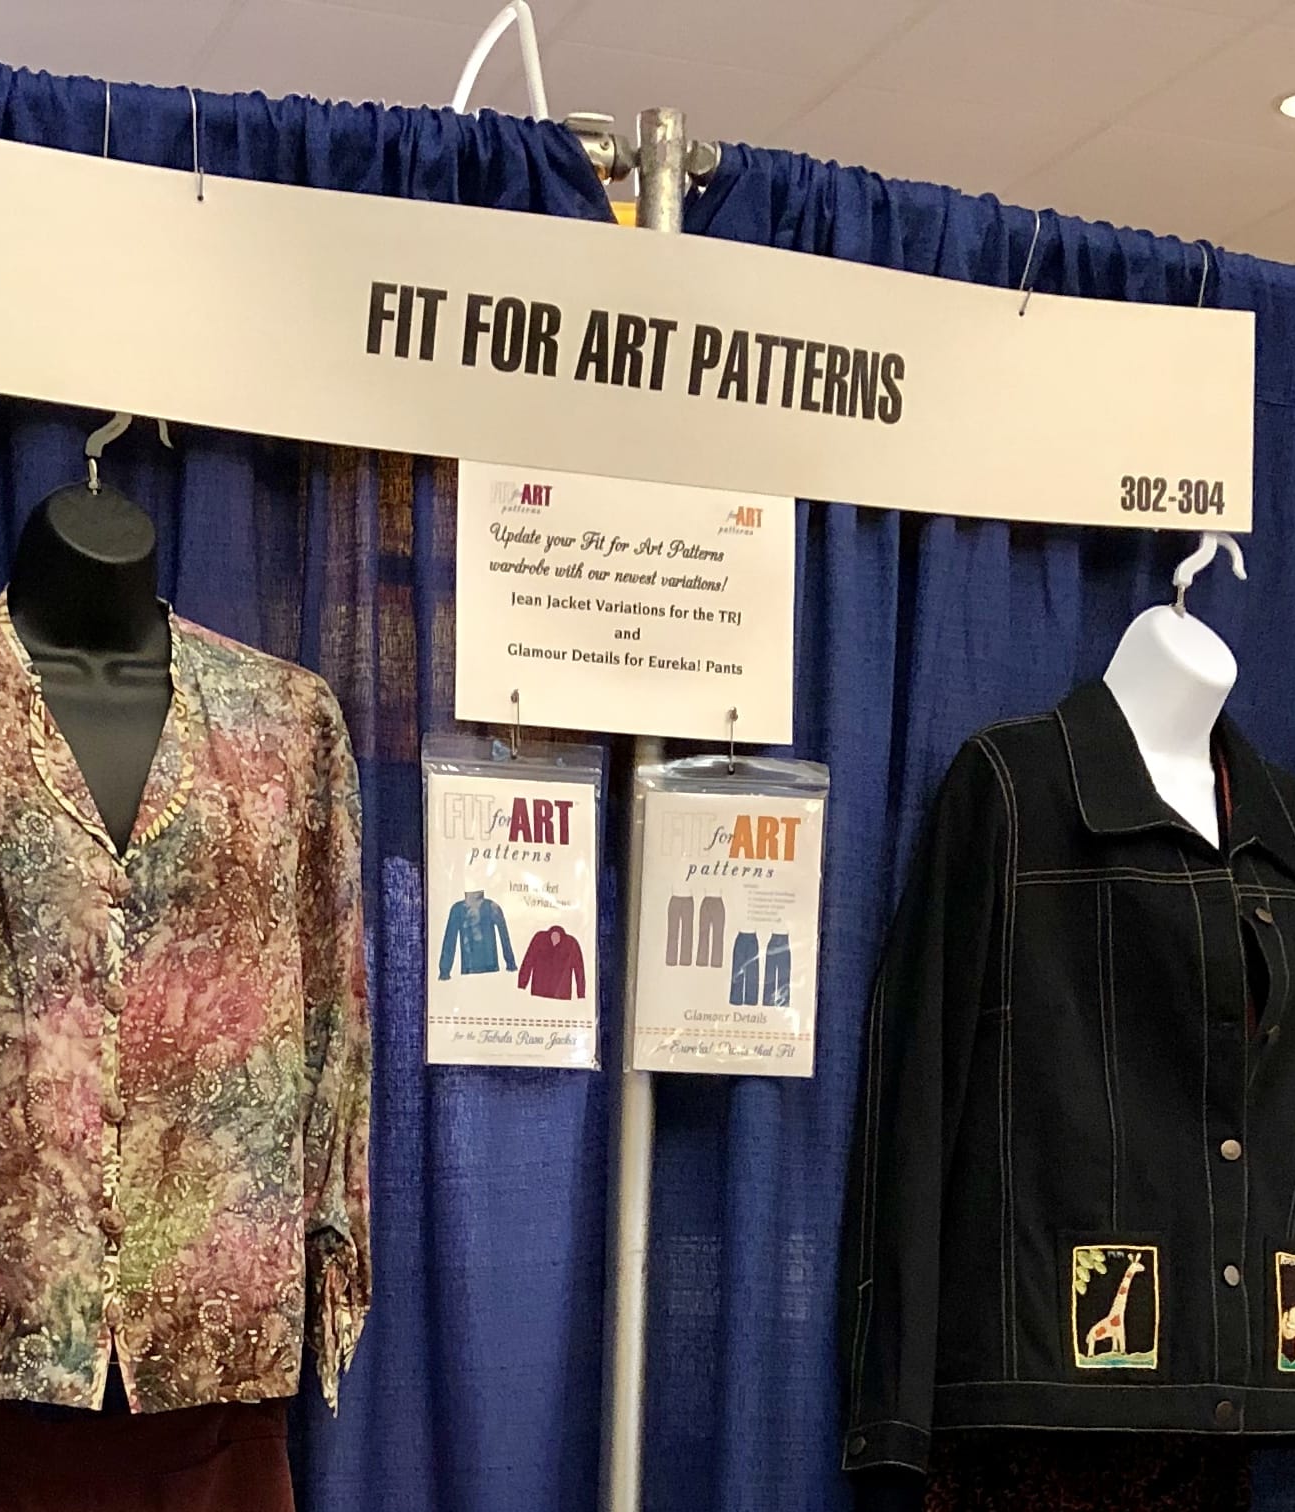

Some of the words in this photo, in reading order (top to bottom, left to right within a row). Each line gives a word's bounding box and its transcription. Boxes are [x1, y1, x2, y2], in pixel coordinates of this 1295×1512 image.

[366, 281, 447, 362] FIT
[461, 293, 562, 377] FOR
[575, 309, 677, 391] ART
[687, 324, 905, 425] PATTERNS
[521, 484, 553, 507] ART
[1121, 475, 1225, 515] 302-304
[501, 505, 541, 515] patterns
[736, 506, 763, 528] ART
[490, 522, 541, 549] Update
[544, 535, 576, 553] your
[580, 531, 606, 550] Fit
[604, 536, 630, 557] for
[634, 537, 663, 556] Art
[667, 539, 724, 562] Patterns
[717, 526, 753, 535] patterns
[490, 557, 550, 576] wardrobe
[554, 561, 584, 579] with
[588, 569, 610, 580] our
[614, 571, 657, 585] newest
[661, 575, 728, 592] variations!
[511, 591, 541, 607] Jean
[546, 595, 591, 611] Jacket
[596, 599, 666, 617] Variations
[669, 604, 689, 620] for
[693, 606, 714, 622] the
[719, 610, 742, 626] TRJ
[614, 627, 641, 640] and
[507, 643, 567, 660] Glamour
[572, 649, 620, 665] Details
[624, 652, 644, 667] for
[649, 655, 701, 672] Eureka!
[705, 660, 743, 675] Pants
[444, 792, 495, 841] FIT
[486, 808, 512, 834] for
[509, 797, 573, 845] ART
[704, 826, 736, 851] for
[729, 815, 801, 861] ART
[469, 844, 552, 865] patterns
[686, 861, 774, 882] patterns
[733, 1012, 767, 1024] Details
